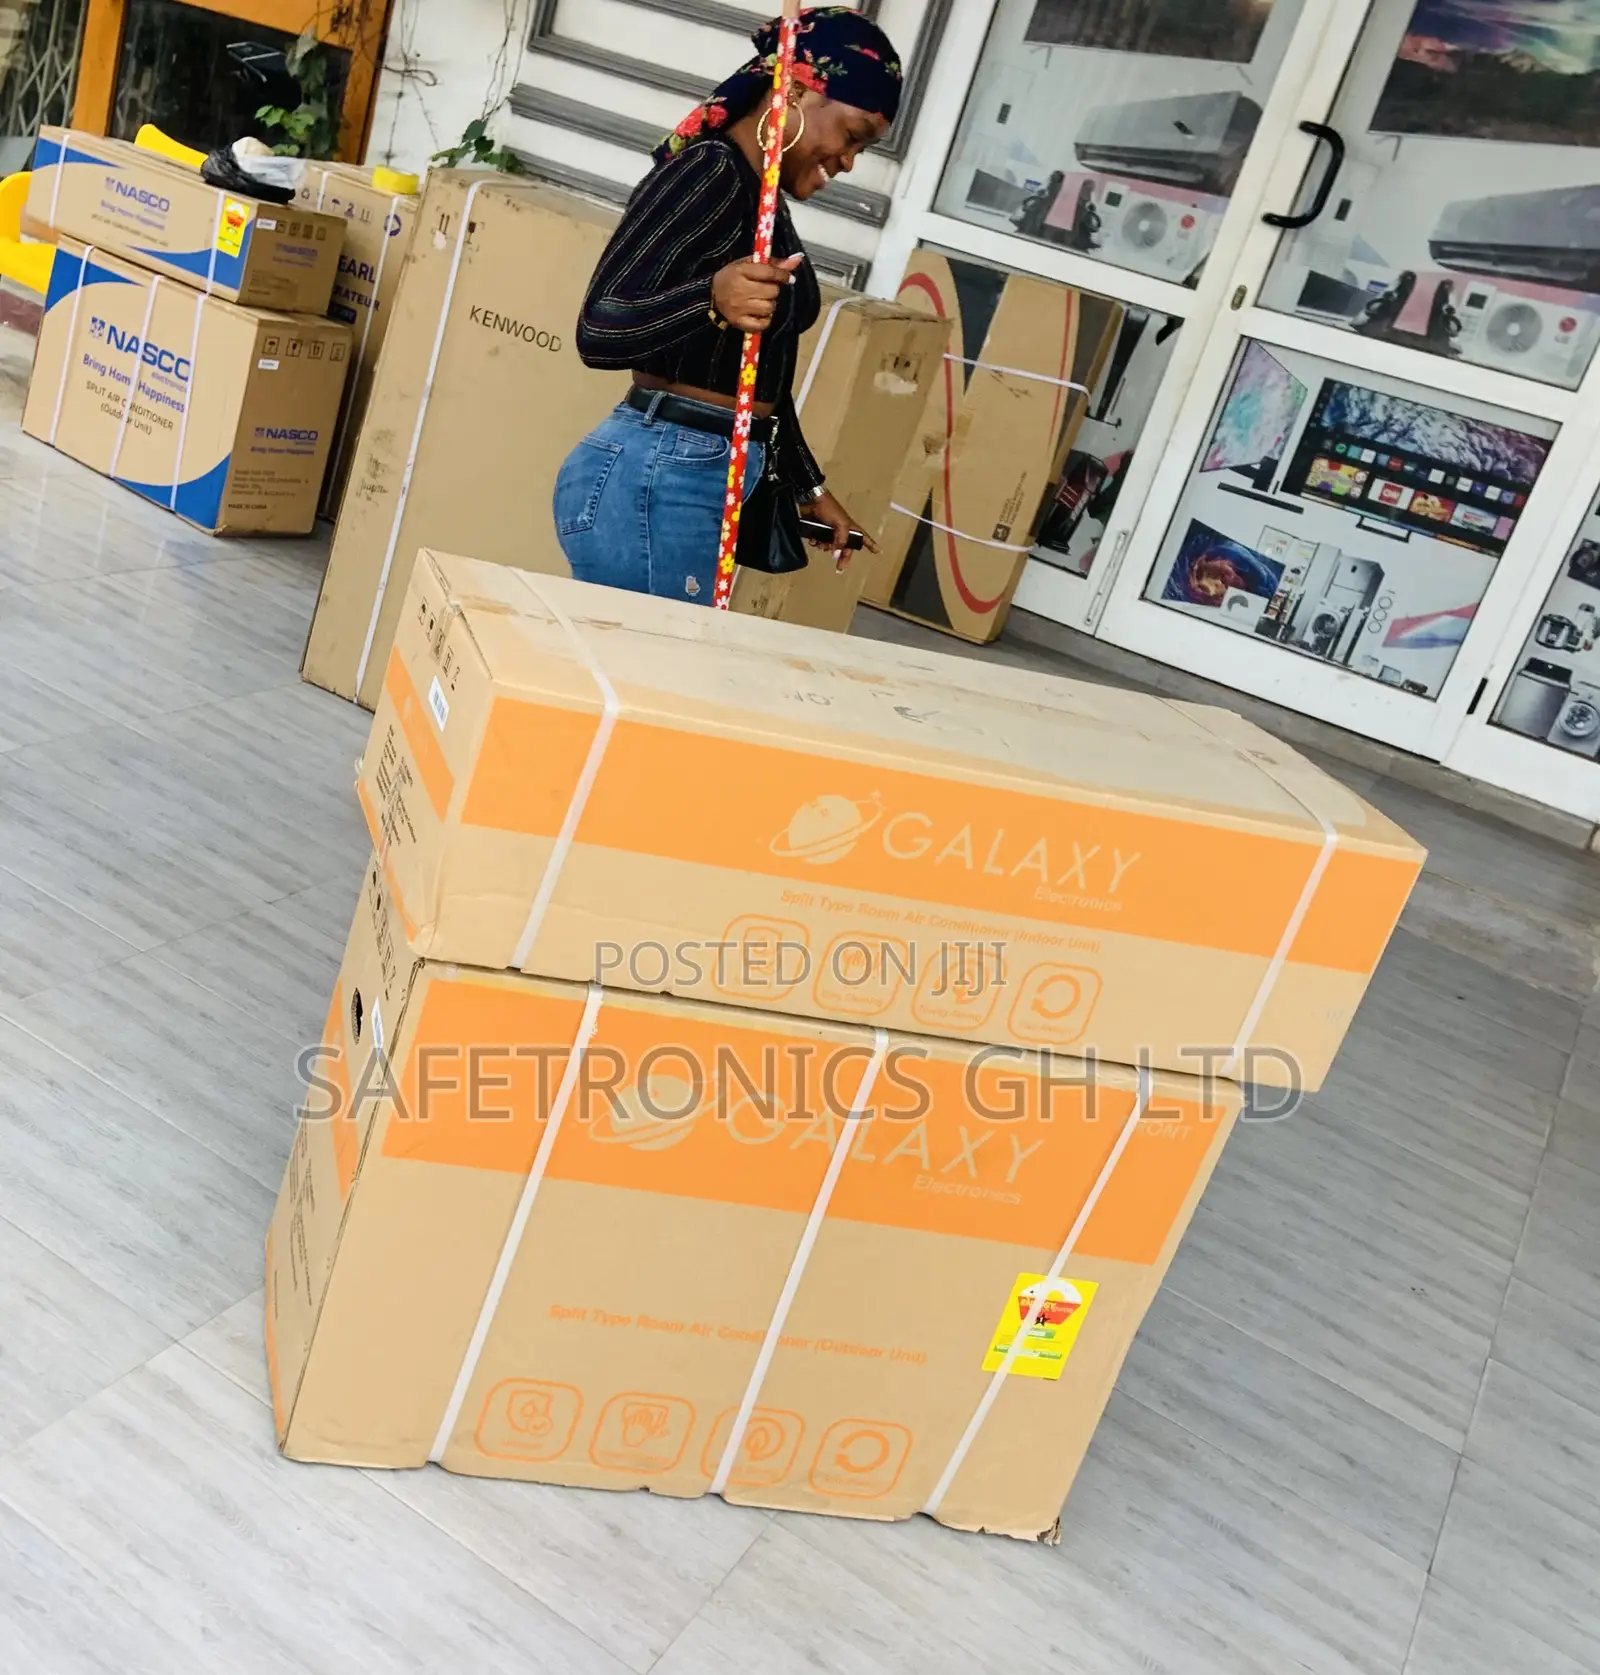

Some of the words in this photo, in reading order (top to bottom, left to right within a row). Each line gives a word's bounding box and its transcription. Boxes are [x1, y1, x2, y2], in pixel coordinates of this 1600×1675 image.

[116, 181, 170, 212] NASCO
[338, 255, 376, 284] EARL
[335, 285, 380, 311] RATEUR
[470, 305, 562, 353] KENWOOD
[83, 353, 106, 377] Bring
[109, 366, 132, 386] Hom
[138, 380, 185, 413] Happiness
[86, 380, 106, 397] SPLIT
[107, 391, 120, 404] AIR
[121, 398, 174, 431] CNDITIONER
[265, 428, 319, 441] NASCO
[882, 812, 1141, 894] GALAXY
[781, 889, 813, 907] Split
[820, 895, 854, 913] Type
[857, 902, 900, 921] Room
[904, 910, 924, 925] Air
[929, 914, 1009, 939] Conditioner
[1034, 885, 1122, 912] Electronics
[726, 1092, 1045, 1184] GALAXY
[912, 1174, 1023, 1206] Electronics
[549, 1304, 587, 1321] Split
[592, 1308, 632, 1327] Type
[637, 1315, 684, 1333] Room
[689, 1322, 713, 1336] Air
